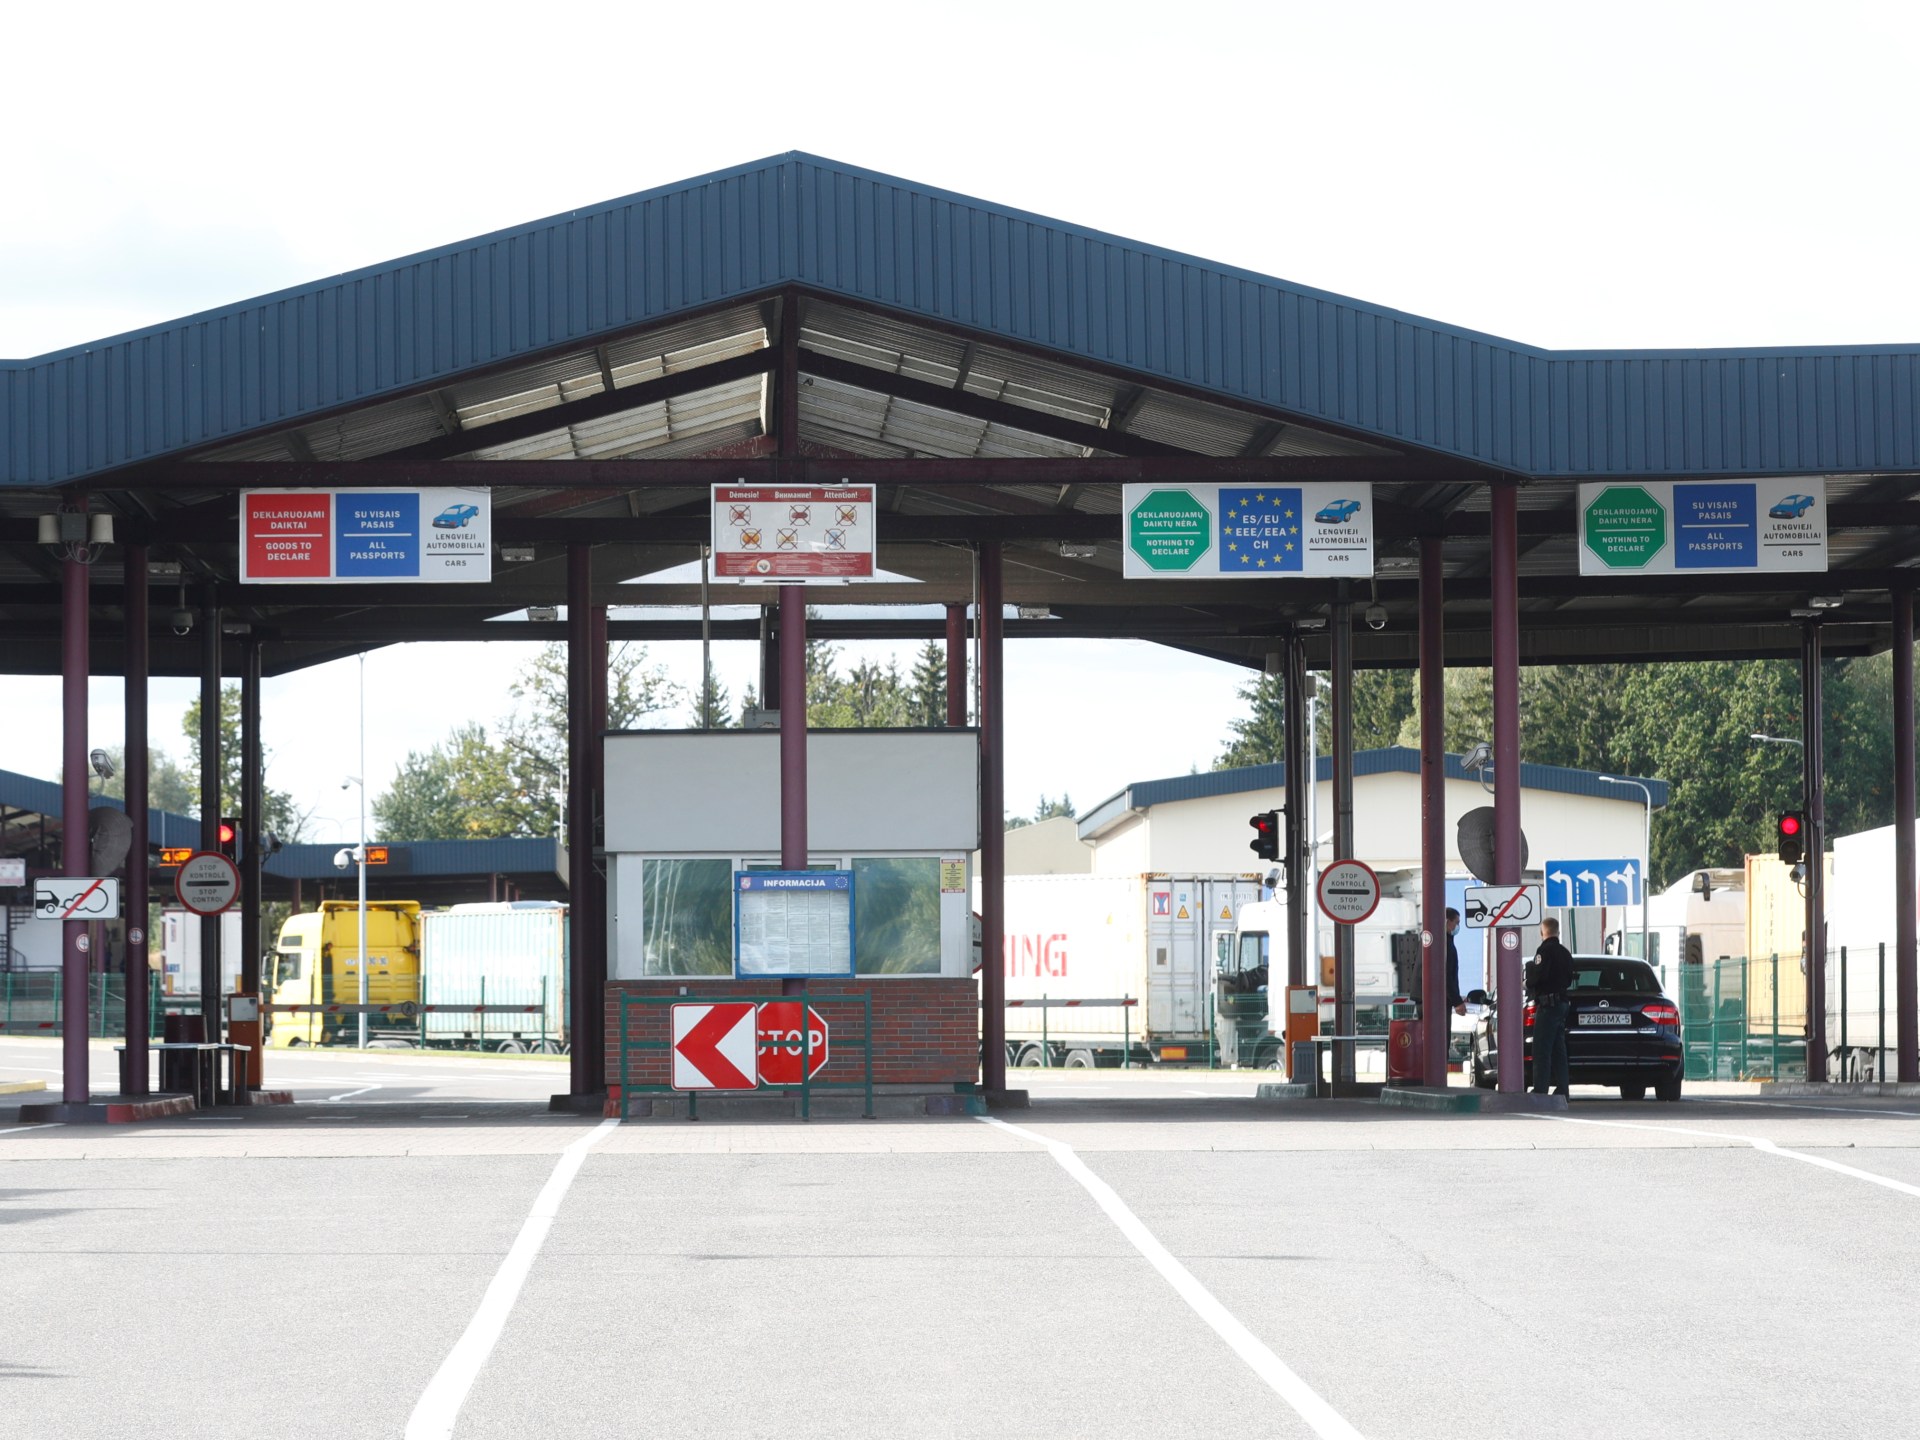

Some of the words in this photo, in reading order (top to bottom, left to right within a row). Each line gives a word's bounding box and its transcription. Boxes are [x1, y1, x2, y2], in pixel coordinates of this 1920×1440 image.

[774, 490, 812, 499] Внимание!
[824, 490, 858, 499] Attention!
[1692, 502, 1705, 510] SU
[1707, 501, 1738, 510] VISAIS
[252, 510, 325, 519] DEKLARUOJAMI
[354, 510, 367, 519] SU
[370, 510, 401, 519] VISAIS
[1698, 511, 1732, 520] PASAIS
[1242, 514, 1279, 525] ES/EU
[270, 521, 307, 530] DAIKTAI
[360, 521, 395, 529] PASAIS
[1772, 523, 1813, 531] LENGVIEJI
[1235, 527, 1287, 538] EEE/EEA
[1707, 532, 1725, 540] ALL
[1763, 532, 1822, 540] AUTOMOBILIAI
[265, 542, 298, 550] GOODS
[368, 541, 386, 549] ALL
[1253, 541, 1269, 549] CH
[1688, 542, 1743, 551] PASSPORTS
[267, 552, 311, 561] DECLARE
[350, 552, 405, 560] PASSPORTS
[763, 879, 826, 887] INFORMACIJA
[1003, 933, 1067, 977] ING
